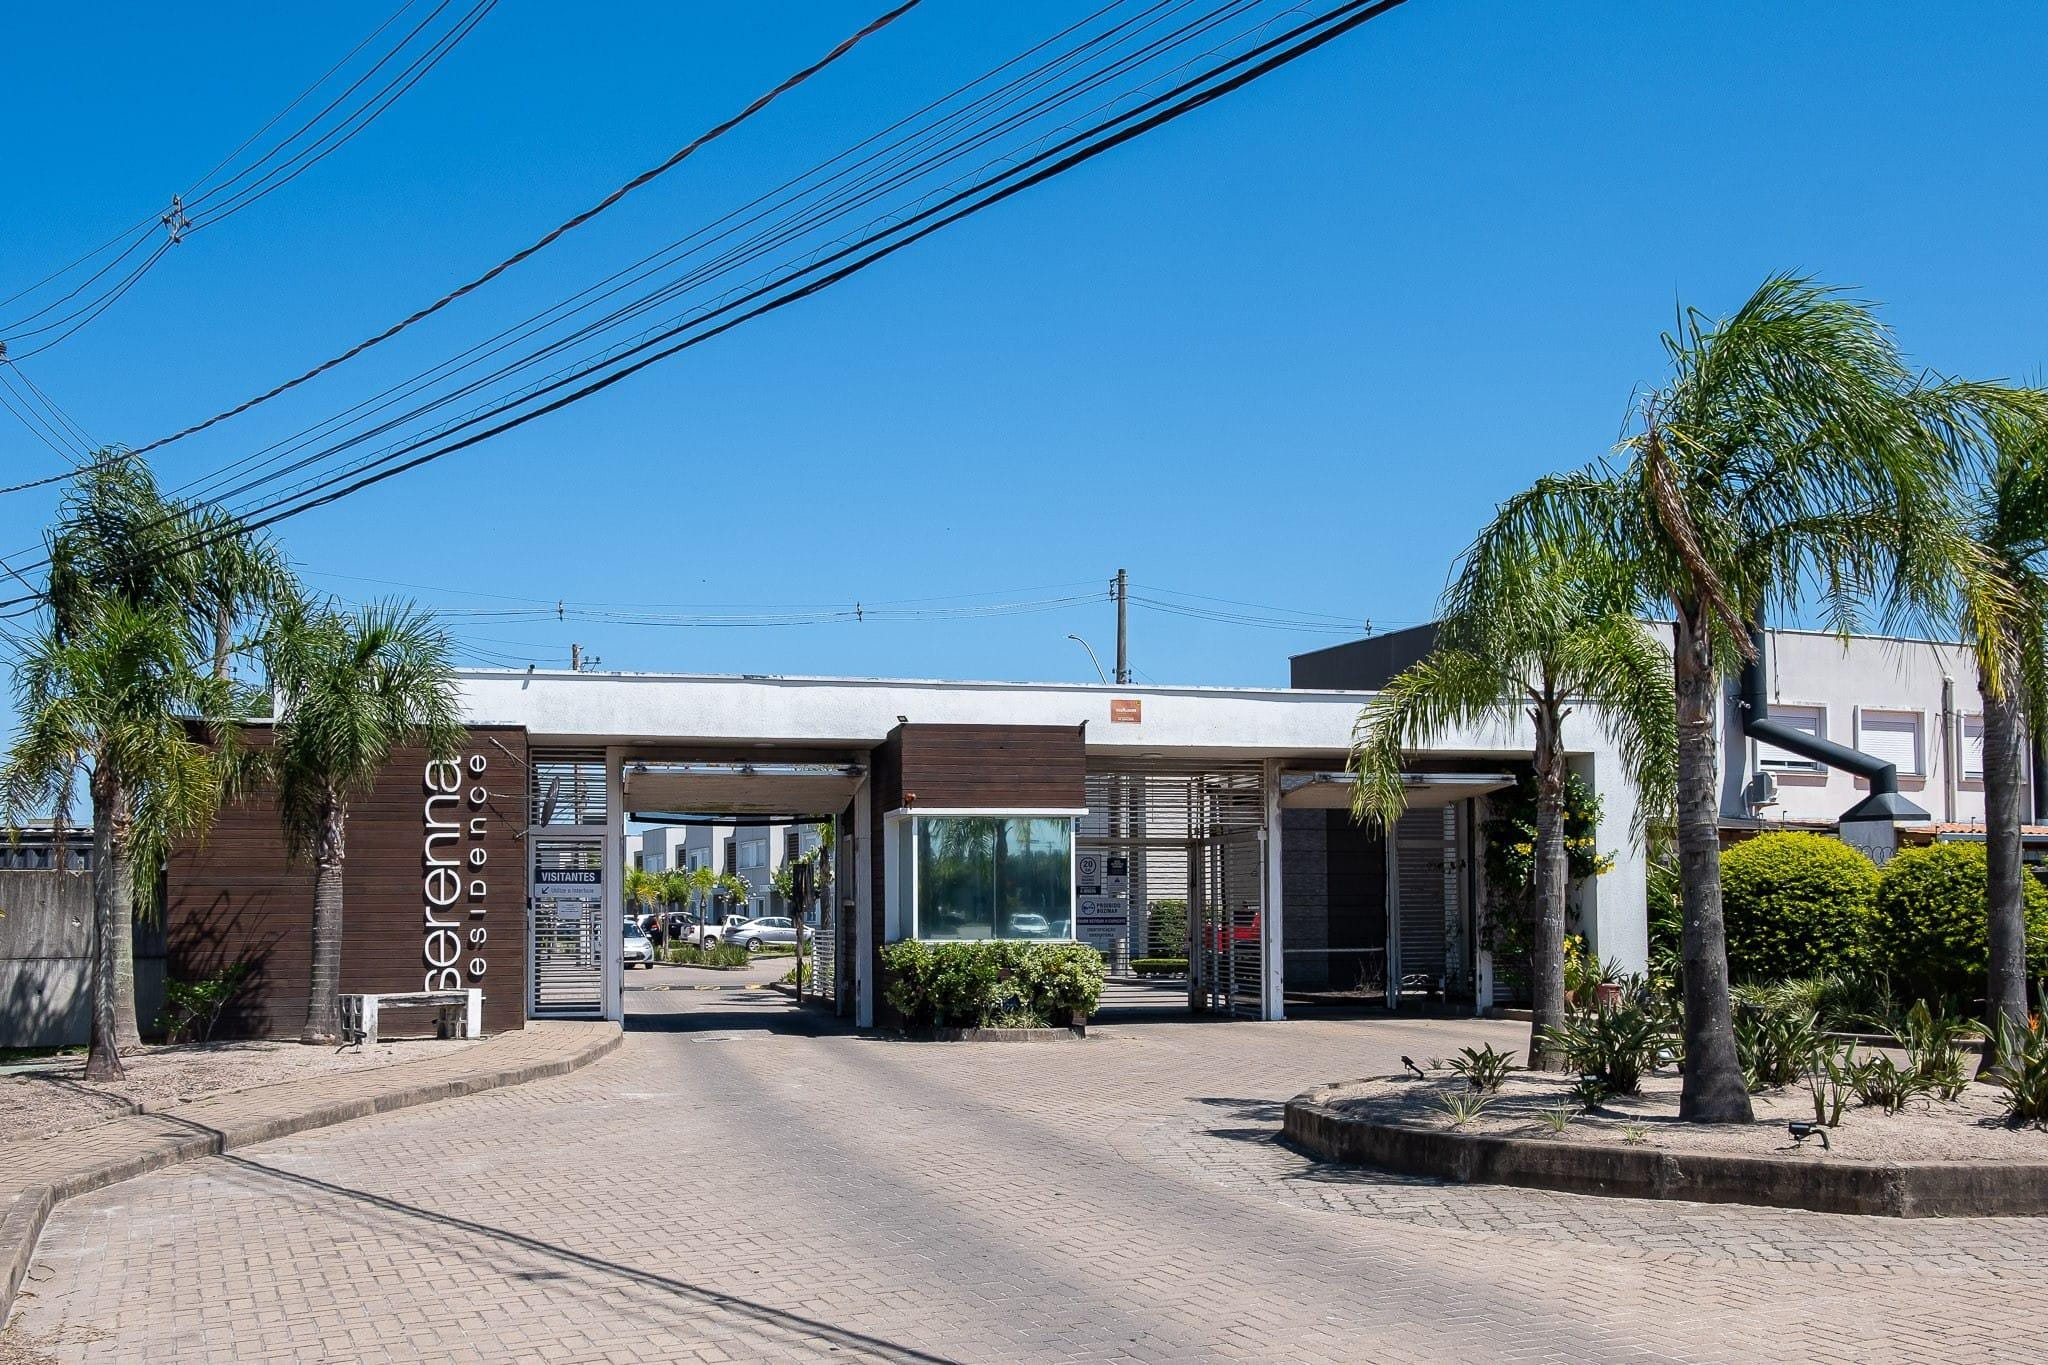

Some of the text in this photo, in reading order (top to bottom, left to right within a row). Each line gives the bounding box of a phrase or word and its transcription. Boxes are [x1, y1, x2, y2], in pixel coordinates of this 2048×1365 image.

[1083, 860, 1093, 868] 20
[424, 755, 462, 992] serenna
[541, 872, 596, 882] VISITANTES
